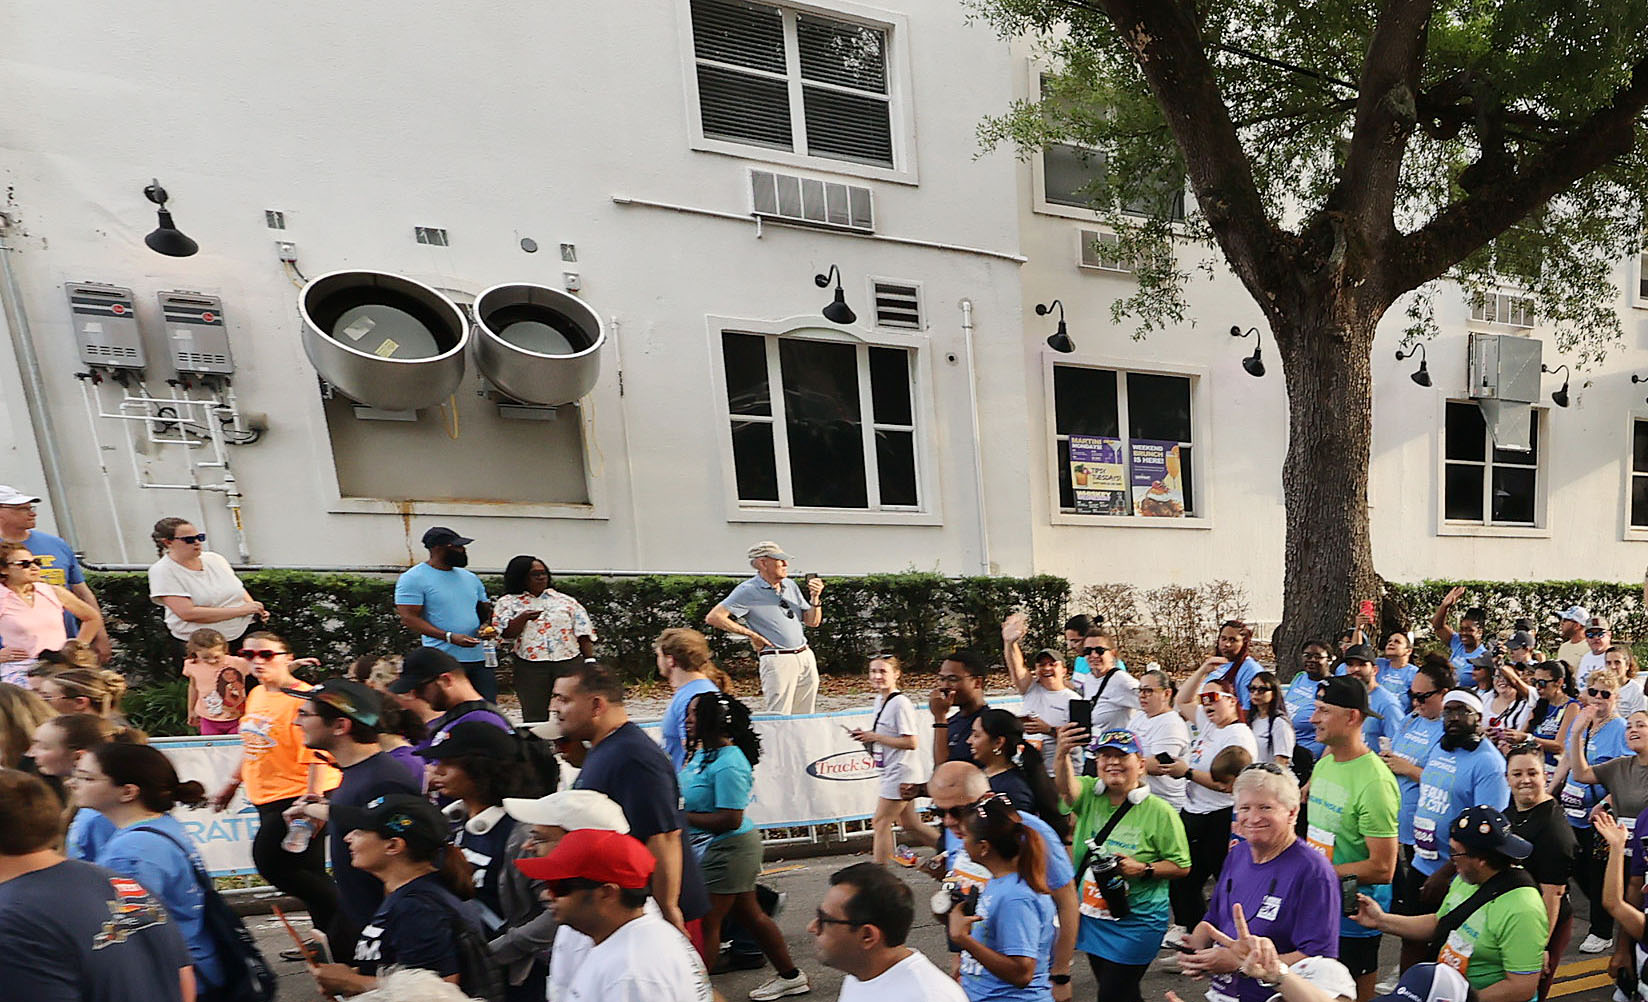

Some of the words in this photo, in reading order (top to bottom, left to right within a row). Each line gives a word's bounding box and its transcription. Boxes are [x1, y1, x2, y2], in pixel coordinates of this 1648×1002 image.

[1132, 444, 1163, 452] WEEKEND
[1132, 450, 1164, 458] BRUNCH
[1142, 457, 1164, 465] HERE!
[816, 757, 859, 775] Track
